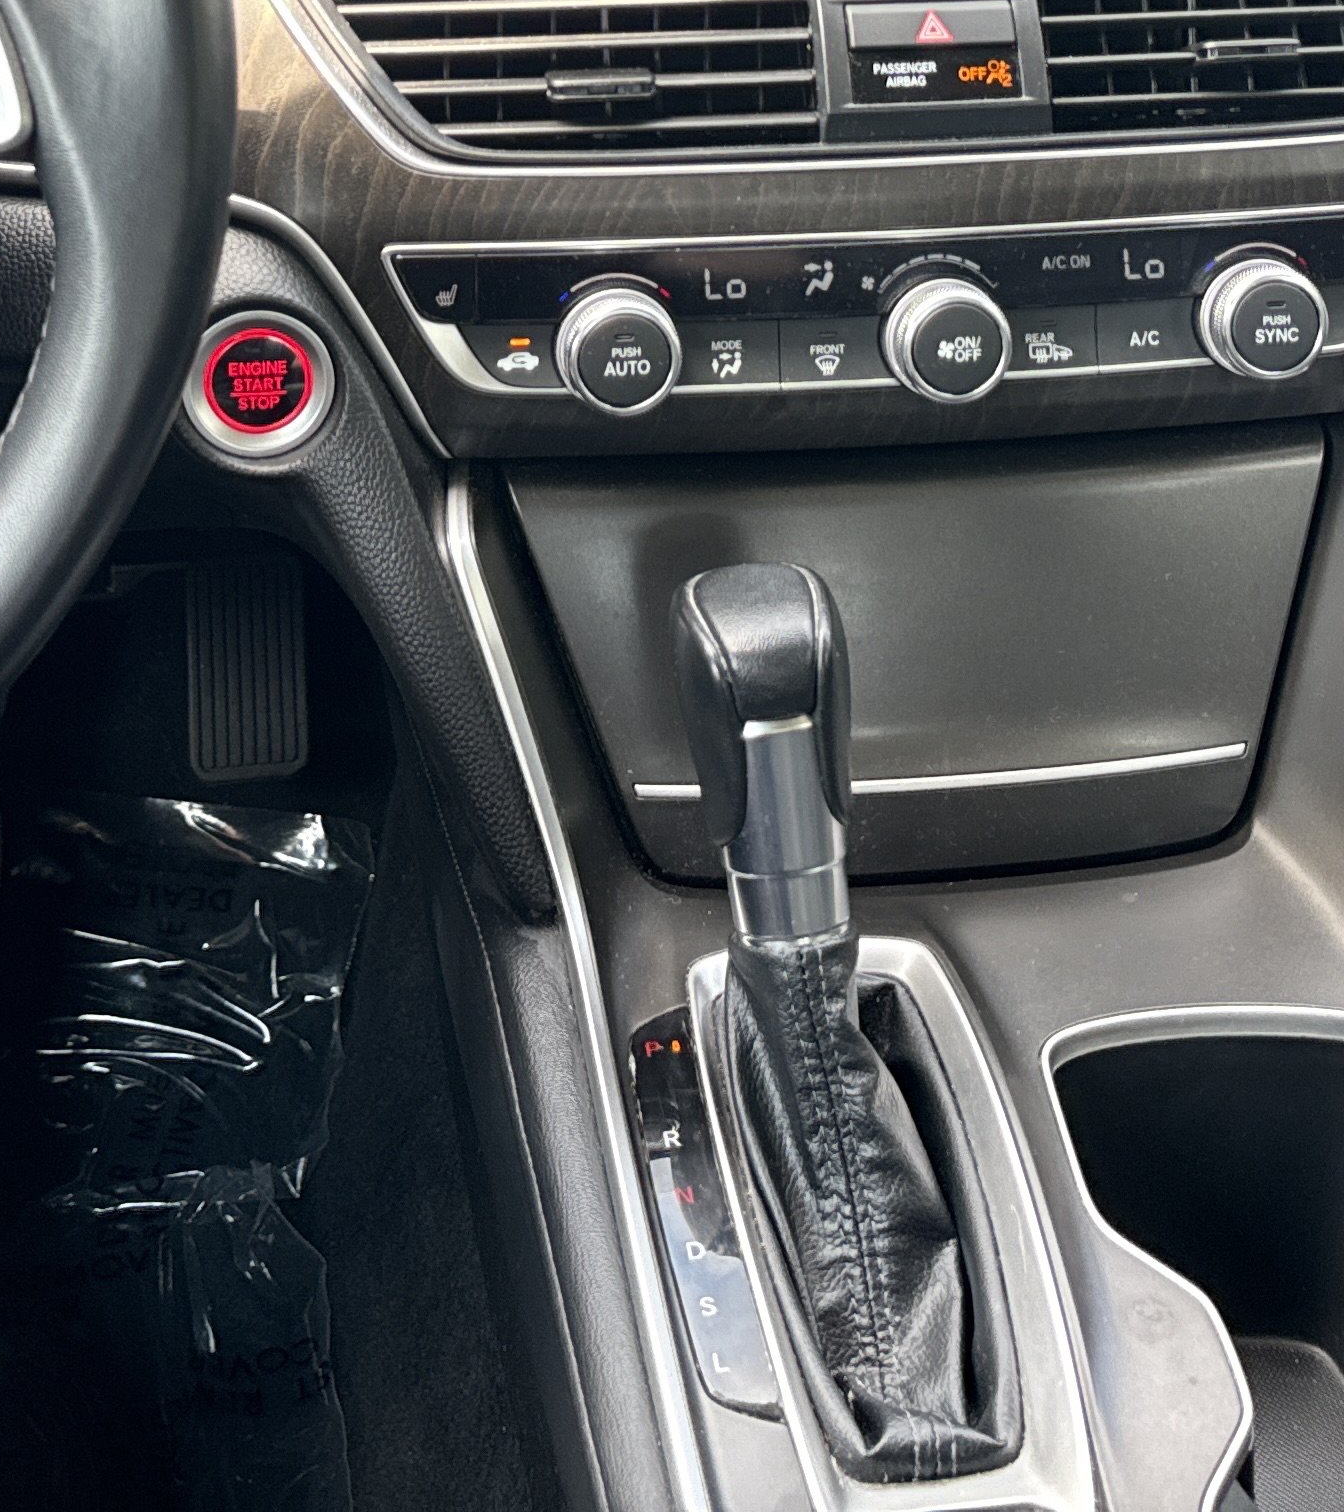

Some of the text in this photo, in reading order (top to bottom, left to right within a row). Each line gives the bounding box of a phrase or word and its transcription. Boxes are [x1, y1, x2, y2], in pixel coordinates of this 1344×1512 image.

[872, 60, 937, 76] PASSENGER
[957, 65, 987, 82] OFF
[885, 74, 927, 88] AIRBAG
[1041, 255, 1091, 270] A/C ON
[1262, 314, 1292, 326] PUSH
[954, 336, 982, 349] ON/
[1025, 332, 1055, 343] REAR
[1129, 330, 1160, 347] A/C
[1254, 327, 1300, 344] SYNC
[611, 346, 643, 359] PUSH
[710, 339, 743, 351] MODE
[809, 344, 845, 355] FRONT
[954, 348, 983, 362] OFF
[227, 360, 288, 377] ENGINE
[604, 359, 651, 377] AUTO
[233, 376, 284, 392] START
[238, 395, 281, 411] STOP
[644, 1039, 664, 1057] P
[662, 1129, 682, 1148] R
[673, 1185, 696, 1205] N
[685, 1240, 707, 1261] D
[699, 1296, 719, 1316] S
[710, 1351, 731, 1374] L
